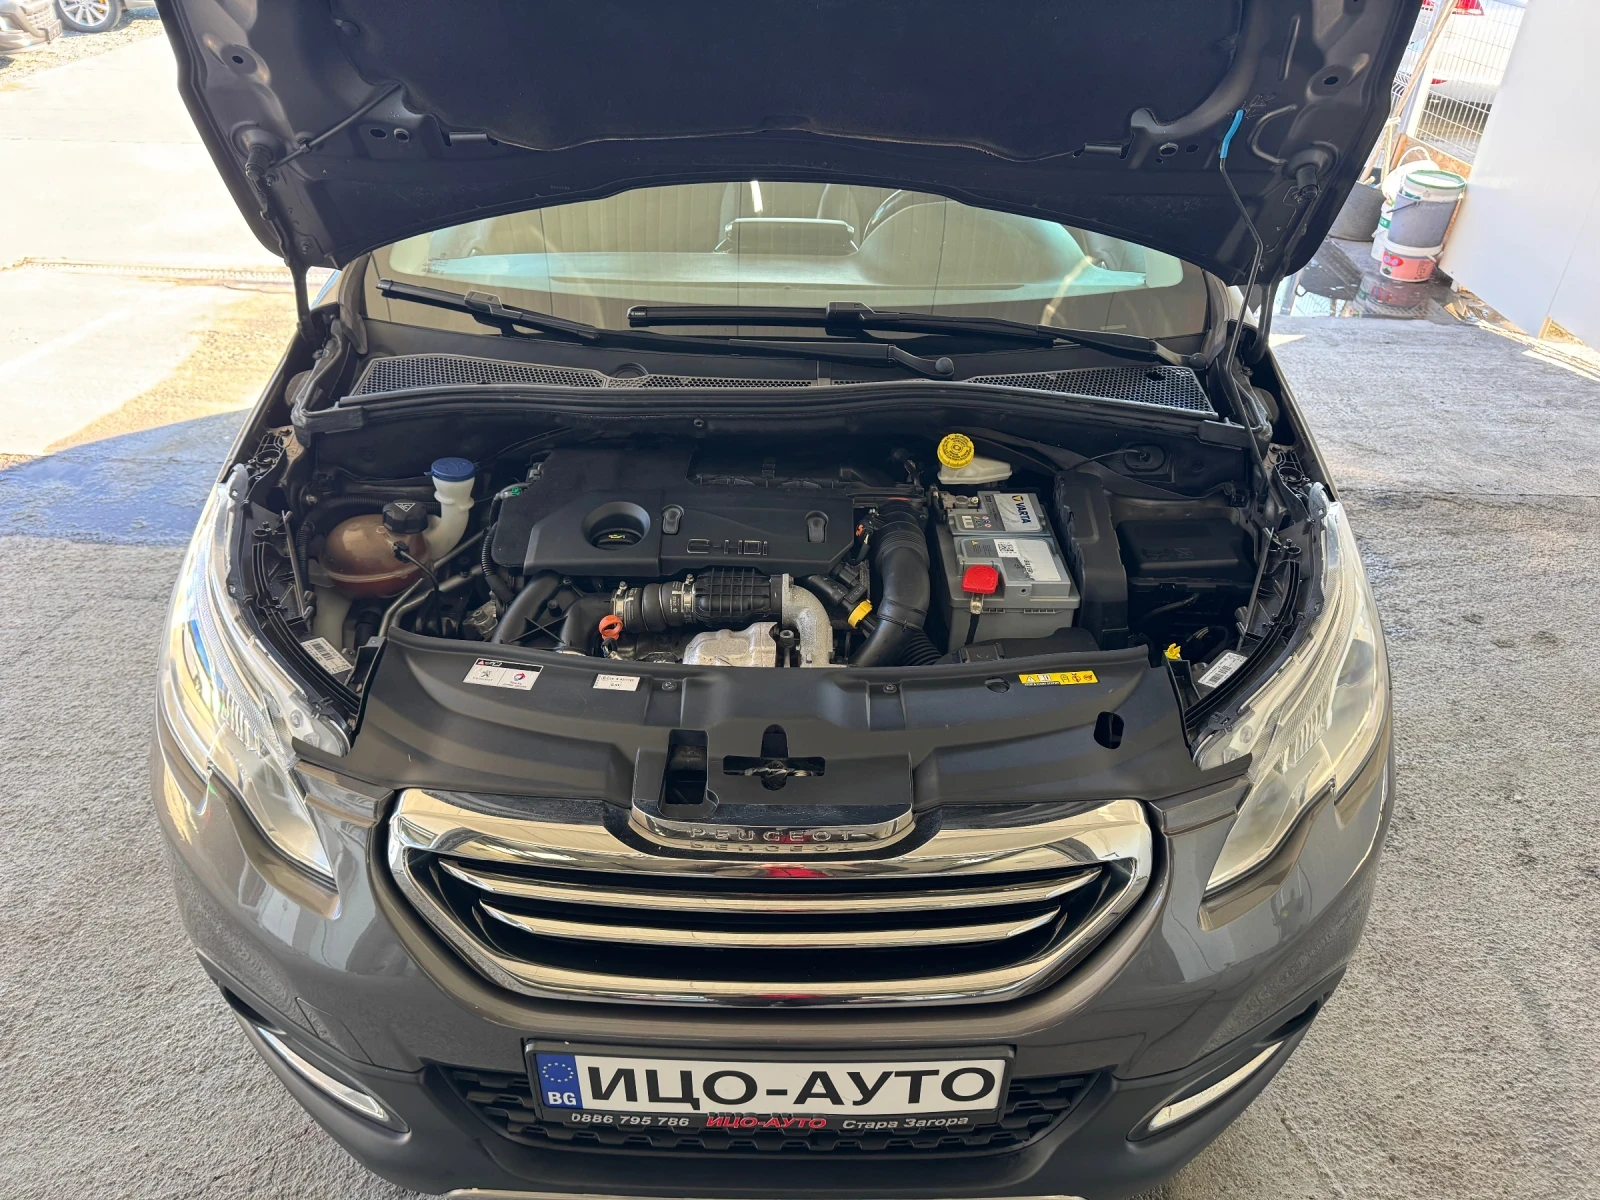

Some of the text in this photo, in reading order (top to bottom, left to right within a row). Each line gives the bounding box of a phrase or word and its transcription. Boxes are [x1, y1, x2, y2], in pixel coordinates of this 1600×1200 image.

[1015, 502, 1032, 523] VARTA
[690, 826, 855, 842] PEUGEOT
[587, 1066, 996, 1111] ИЦО-АУТО
[547, 1091, 577, 1106] BG
[571, 1112, 690, 1127] 0886 795 786
[706, 1115, 827, 1129] ИЦО-АУТО
[842, 1116, 969, 1130] Стара Загора
